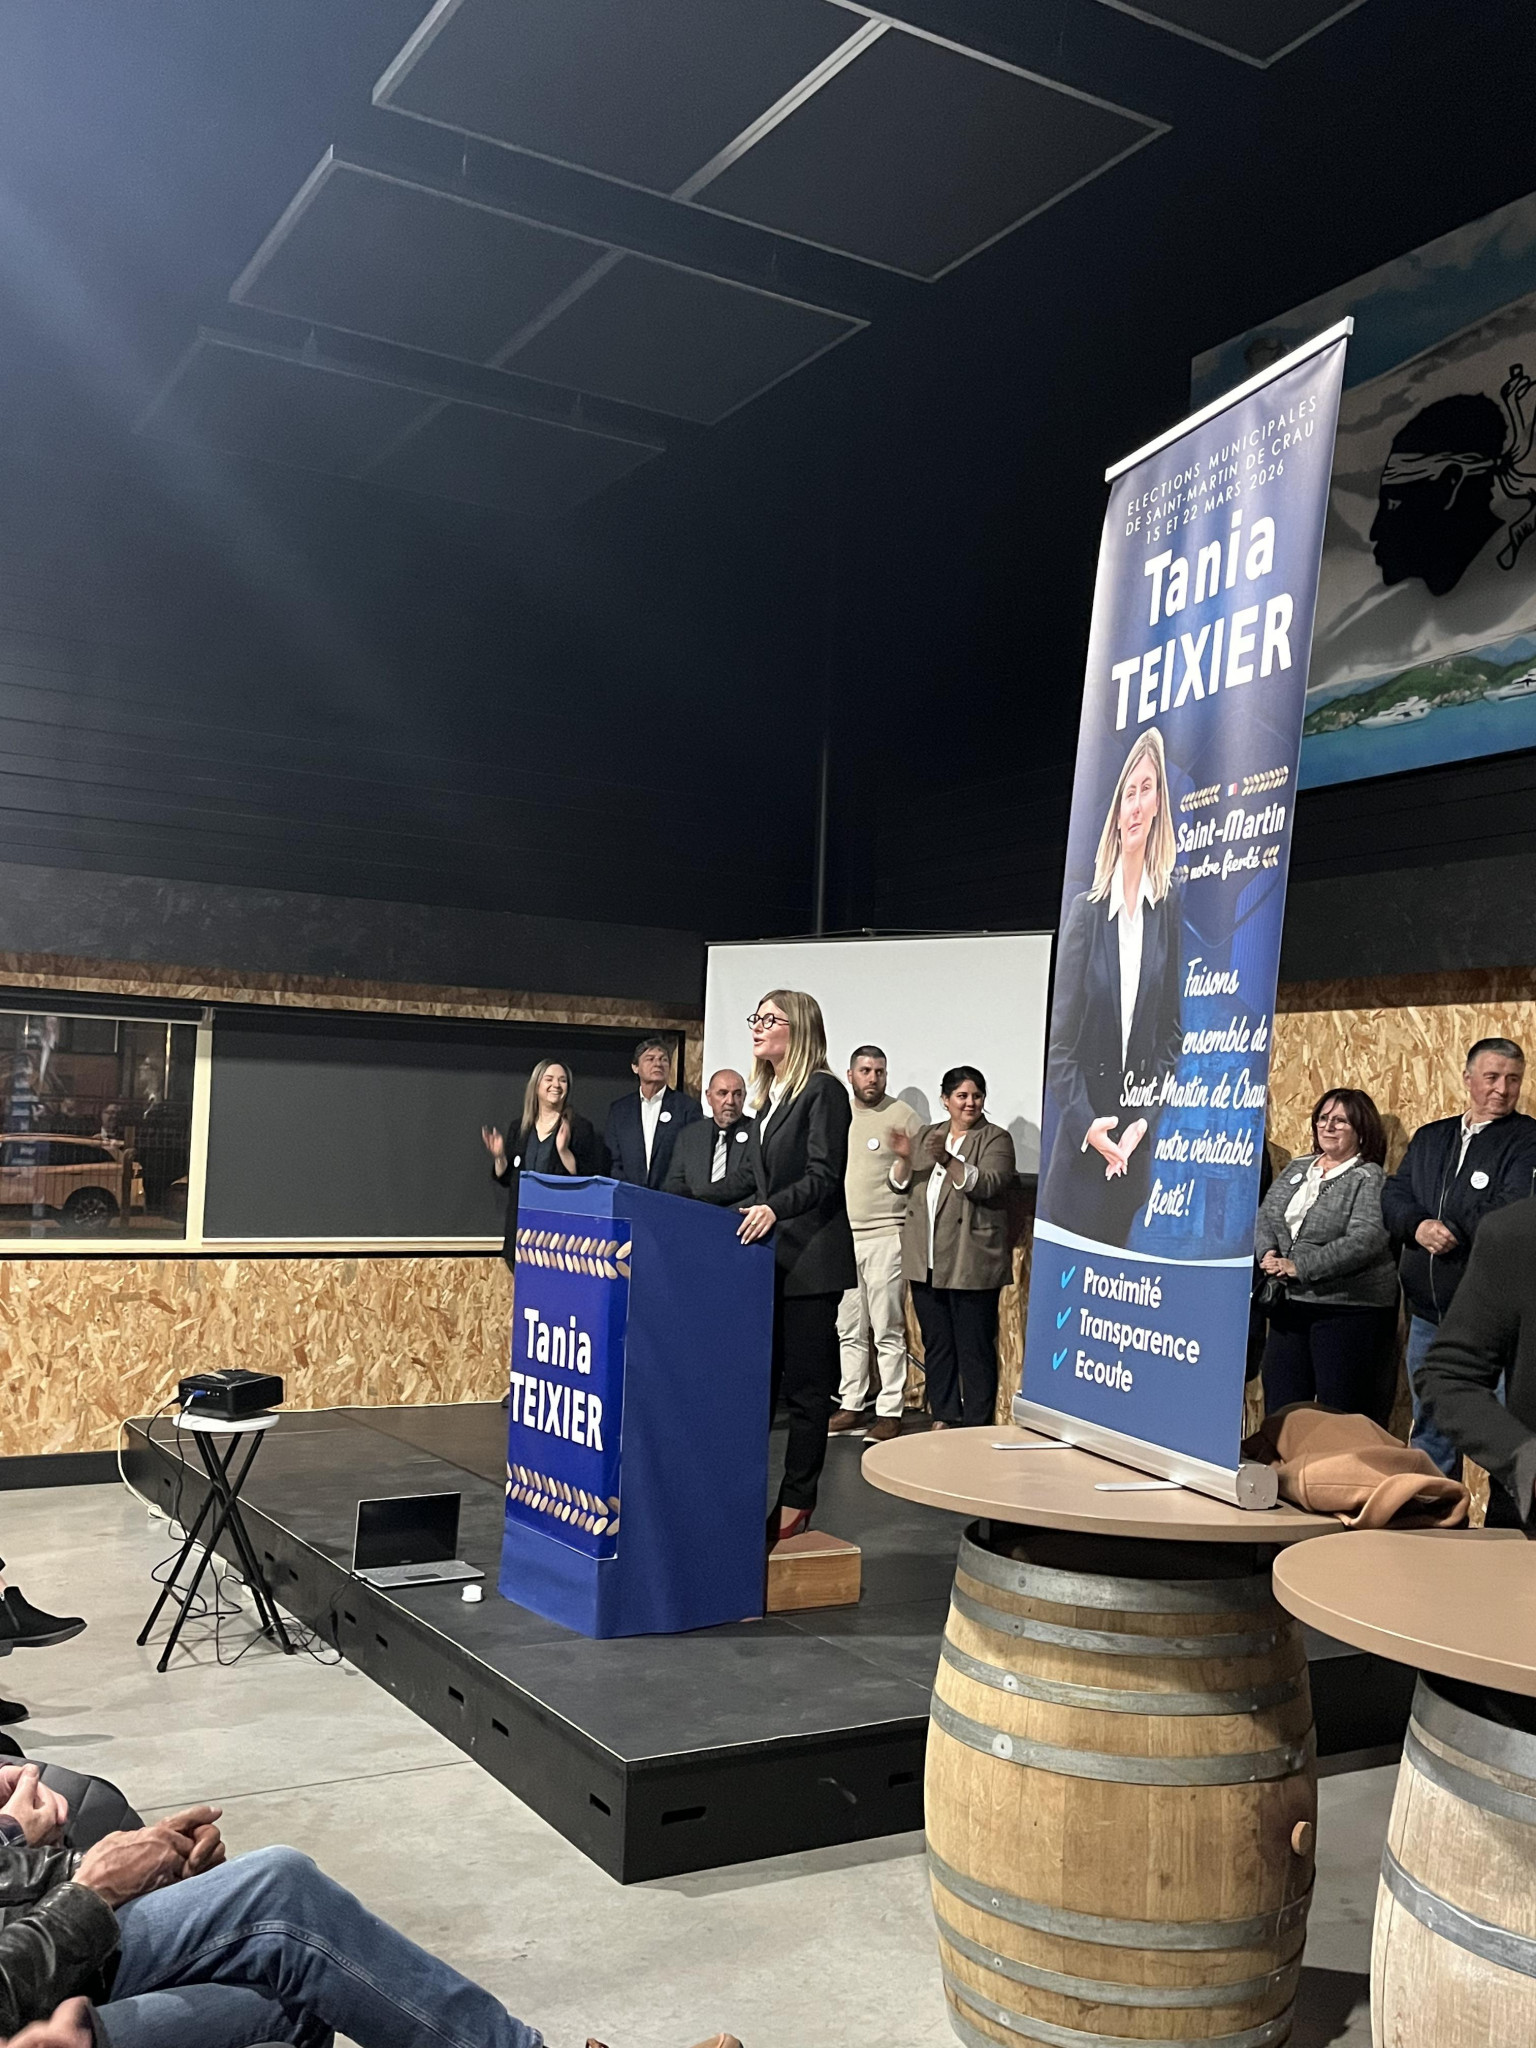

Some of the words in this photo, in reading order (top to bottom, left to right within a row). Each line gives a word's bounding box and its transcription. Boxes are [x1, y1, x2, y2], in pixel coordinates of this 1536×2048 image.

[1125, 516, 1142, 536] DE
[1145, 461, 1239, 525] SAINT-MARTIN
[1246, 448, 1265, 470] DE
[1271, 420, 1314, 456] CRAU
[1127, 462, 1201, 517] ELECTIONS
[1208, 395, 1317, 471] MUNICIPALES
[1146, 530, 1160, 544] 15
[1166, 515, 1179, 535] ET
[1182, 504, 1198, 525] 22
[1203, 481, 1242, 514] MARS
[1249, 459, 1284, 490] 2026
[1144, 509, 1276, 627] Tania
[1111, 592, 1294, 731] TEIXIER
[1176, 802, 1286, 854] Saint-Martin
[1189, 852, 1221, 880] notre
[1220, 846, 1261, 881] fierté
[1184, 957, 1240, 998] Faisons
[1182, 1015, 1250, 1055] ensemble
[1250, 1014, 1268, 1052] de
[1119, 1070, 1210, 1108] Saint-Martin
[1209, 1072, 1232, 1109] de
[1232, 1067, 1266, 1110] Crau
[1154, 1129, 1189, 1163] notre
[1189, 1127, 1254, 1167] véritable
[1083, 1266, 1162, 1309] Proximité
[524, 1307, 591, 1375] Tania
[1080, 1307, 1201, 1364] Transparence
[1074, 1350, 1133, 1392] Ecoute
[509, 1370, 604, 1452] TEIXIER
